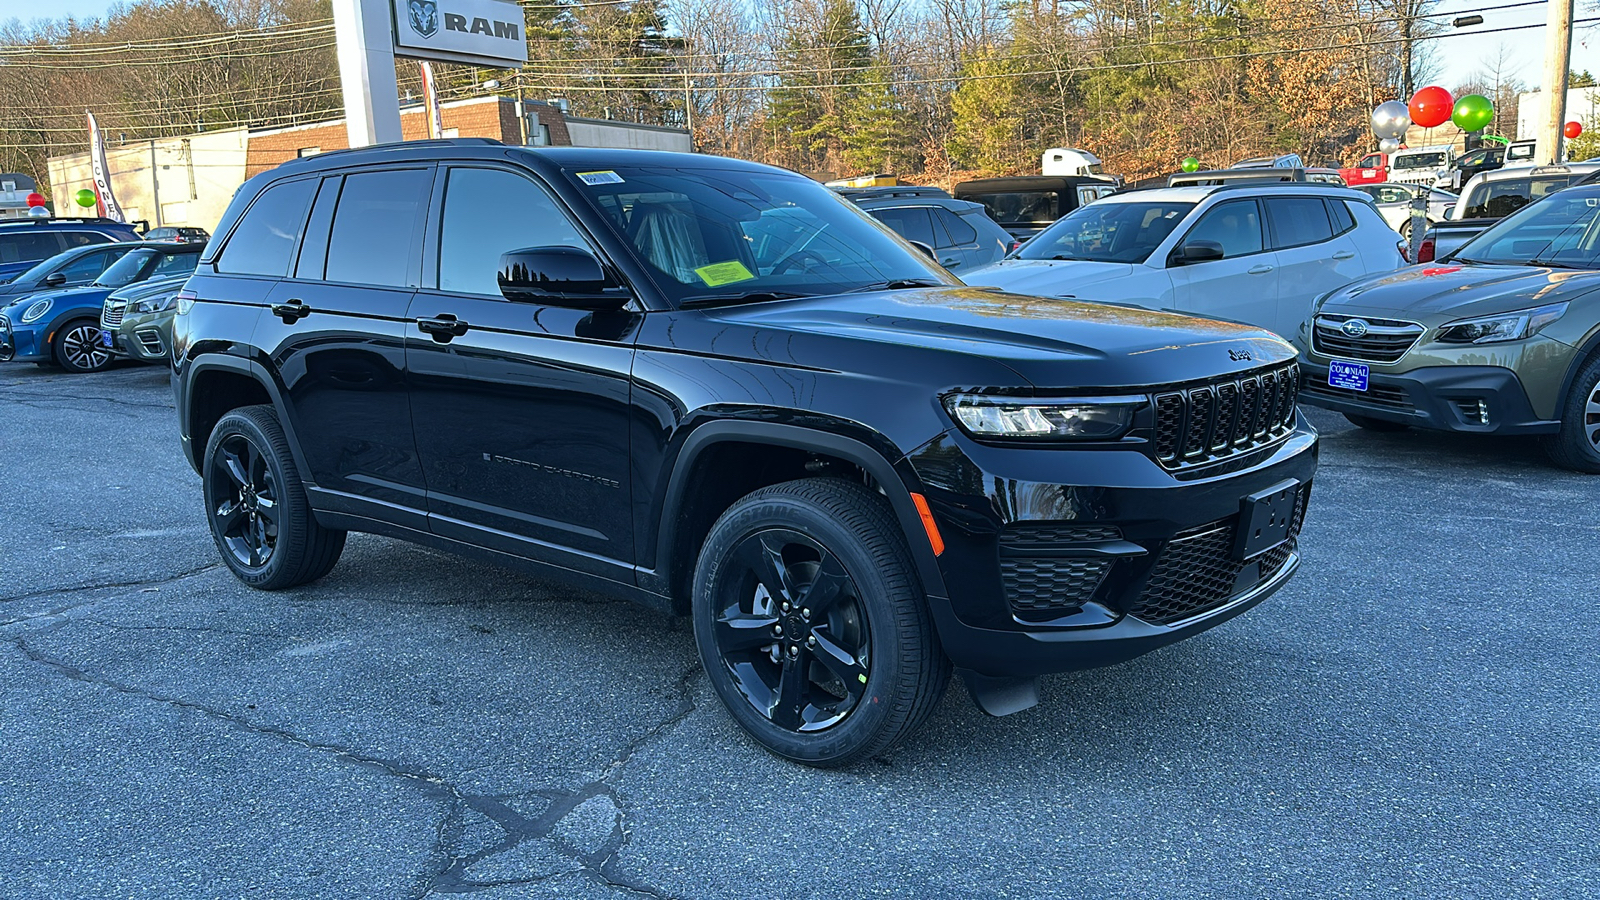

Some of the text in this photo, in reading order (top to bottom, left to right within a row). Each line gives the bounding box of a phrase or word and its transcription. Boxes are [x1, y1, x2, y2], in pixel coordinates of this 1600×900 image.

[444, 12, 519, 41] RAM
[1331, 364, 1367, 377] COLONIAL
[543, 465, 619, 489] CHEROKEE
